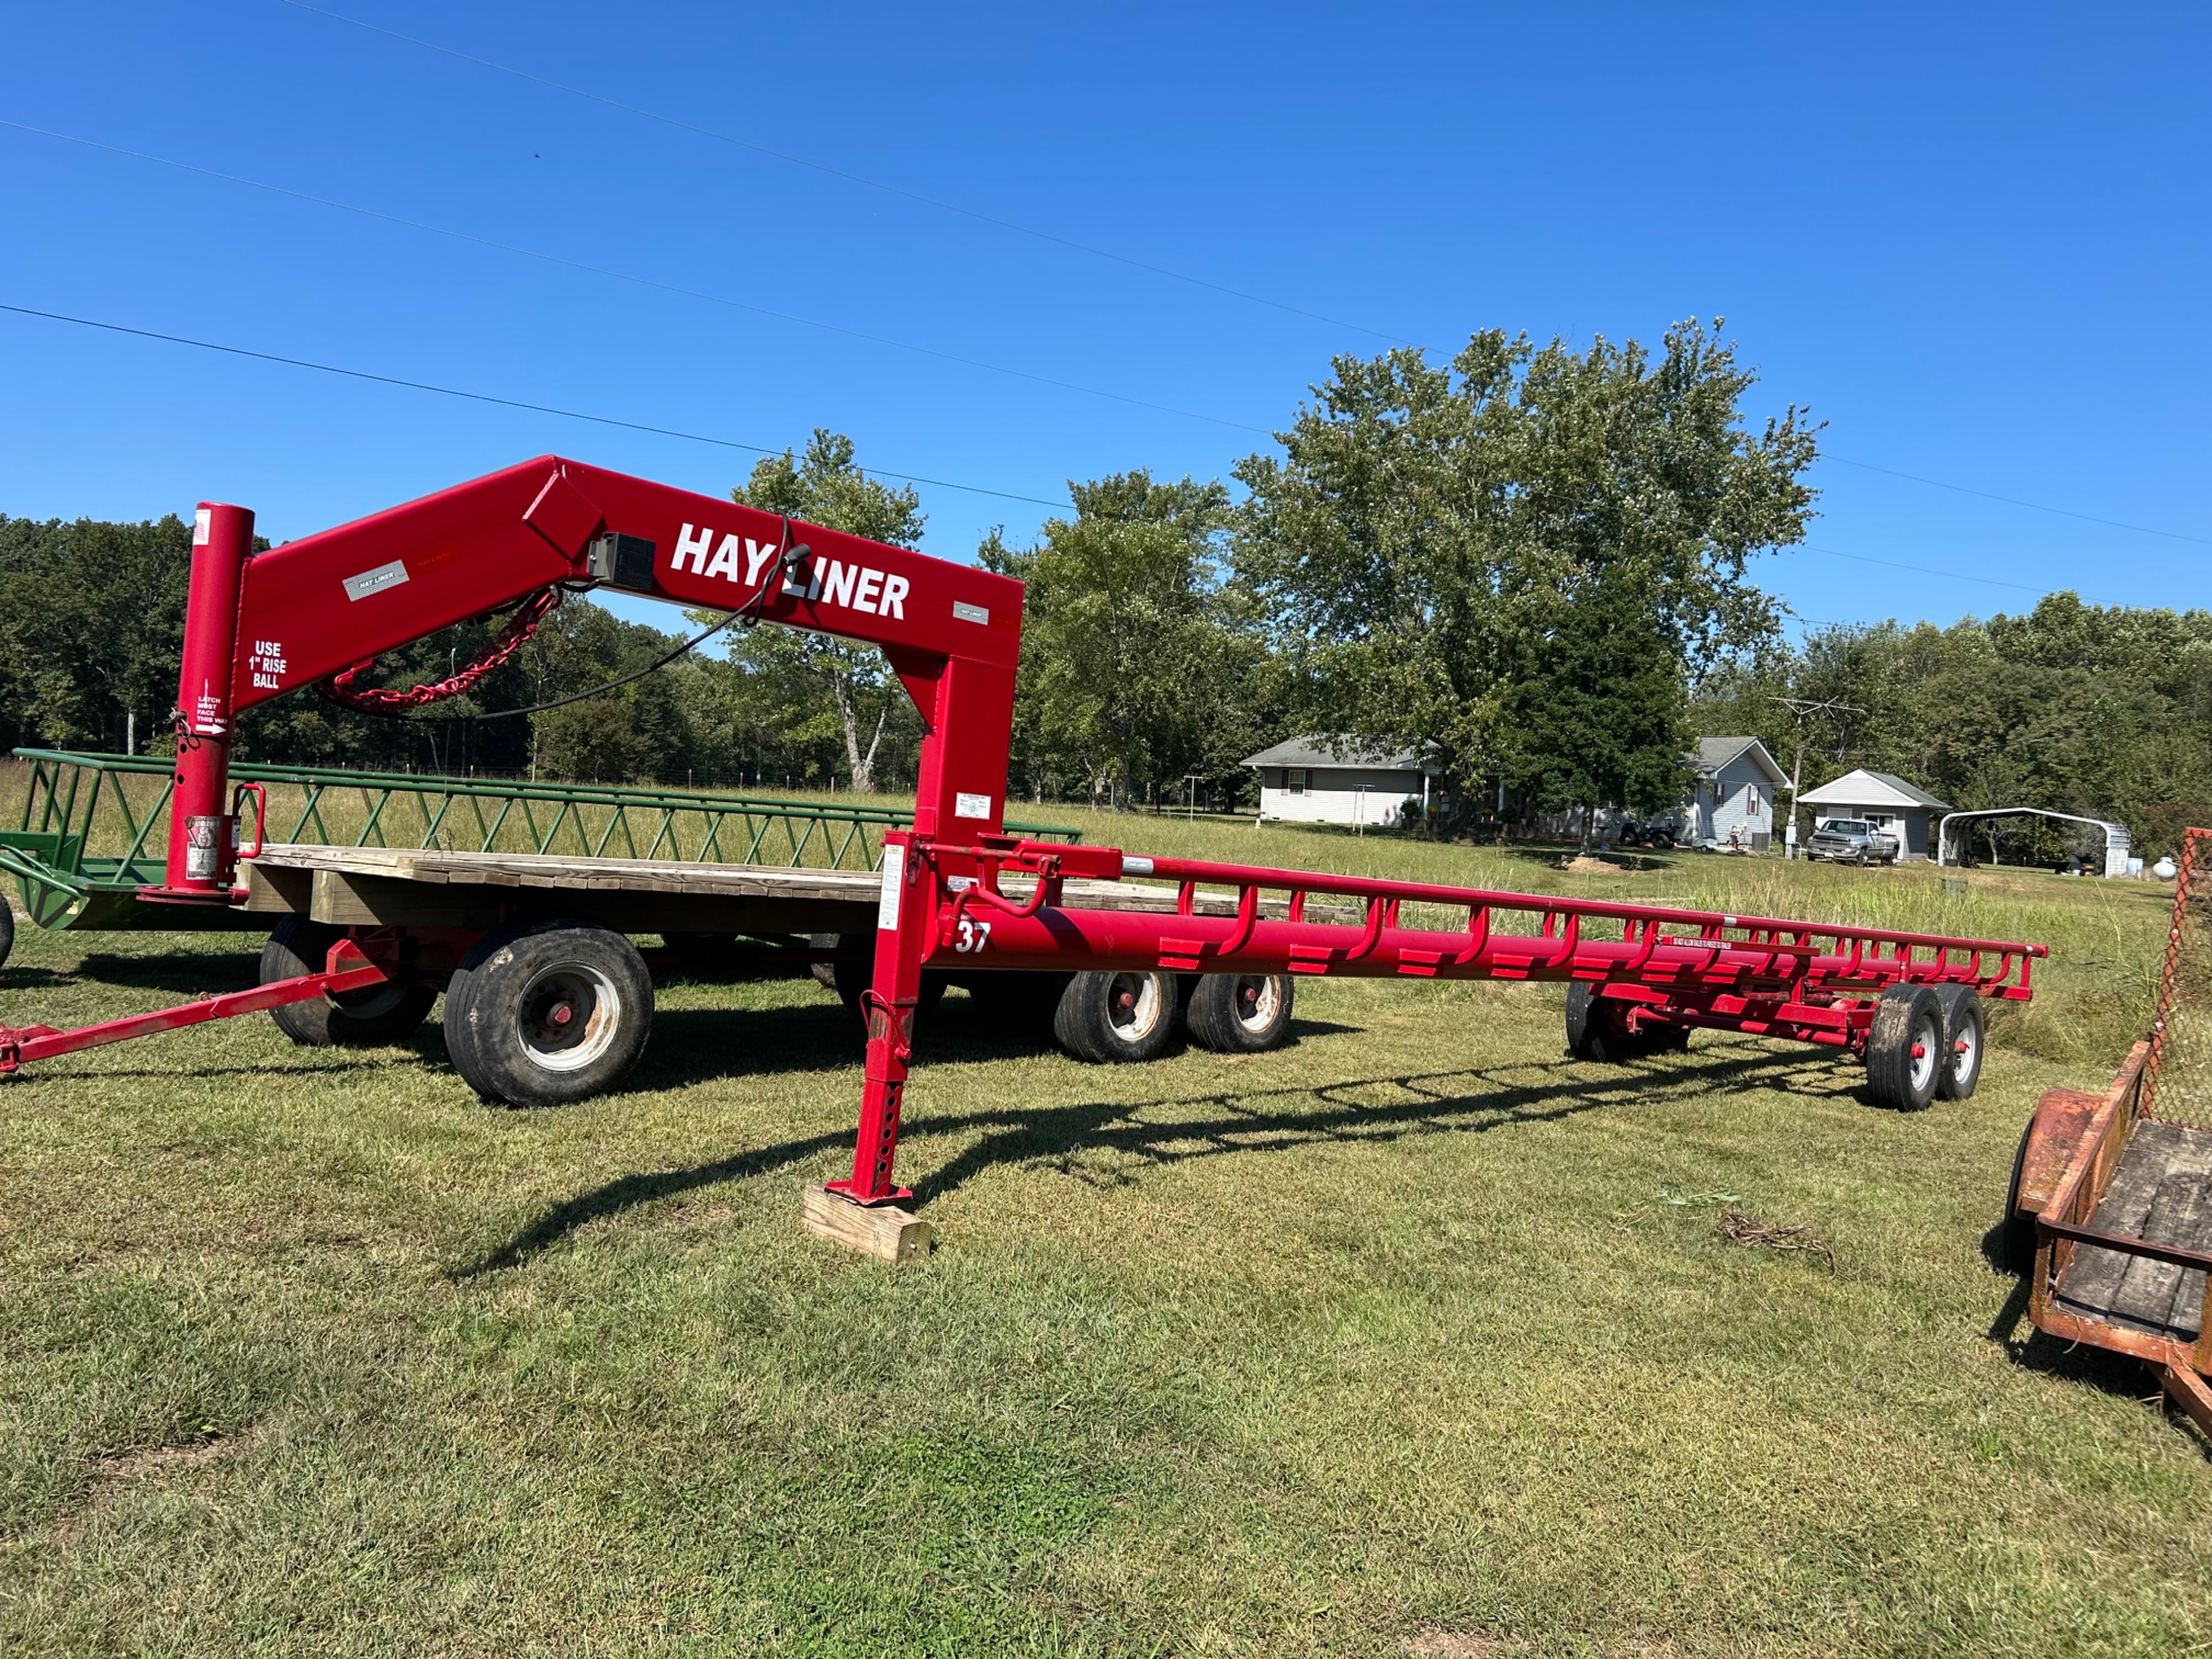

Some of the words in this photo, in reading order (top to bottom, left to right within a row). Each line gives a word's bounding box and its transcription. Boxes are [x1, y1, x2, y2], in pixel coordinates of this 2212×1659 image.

[670, 523, 777, 587] HAY
[781, 556, 910, 620] LINER
[359, 580, 373, 589] HAY
[374, 572, 395, 583] LINER
[255, 640, 281, 657] USE
[249, 656, 260, 670] 1"
[262, 657, 287, 674] RISE
[253, 672, 279, 689] BALL
[198, 696, 221, 704] LATCH
[955, 921, 991, 953] 37
